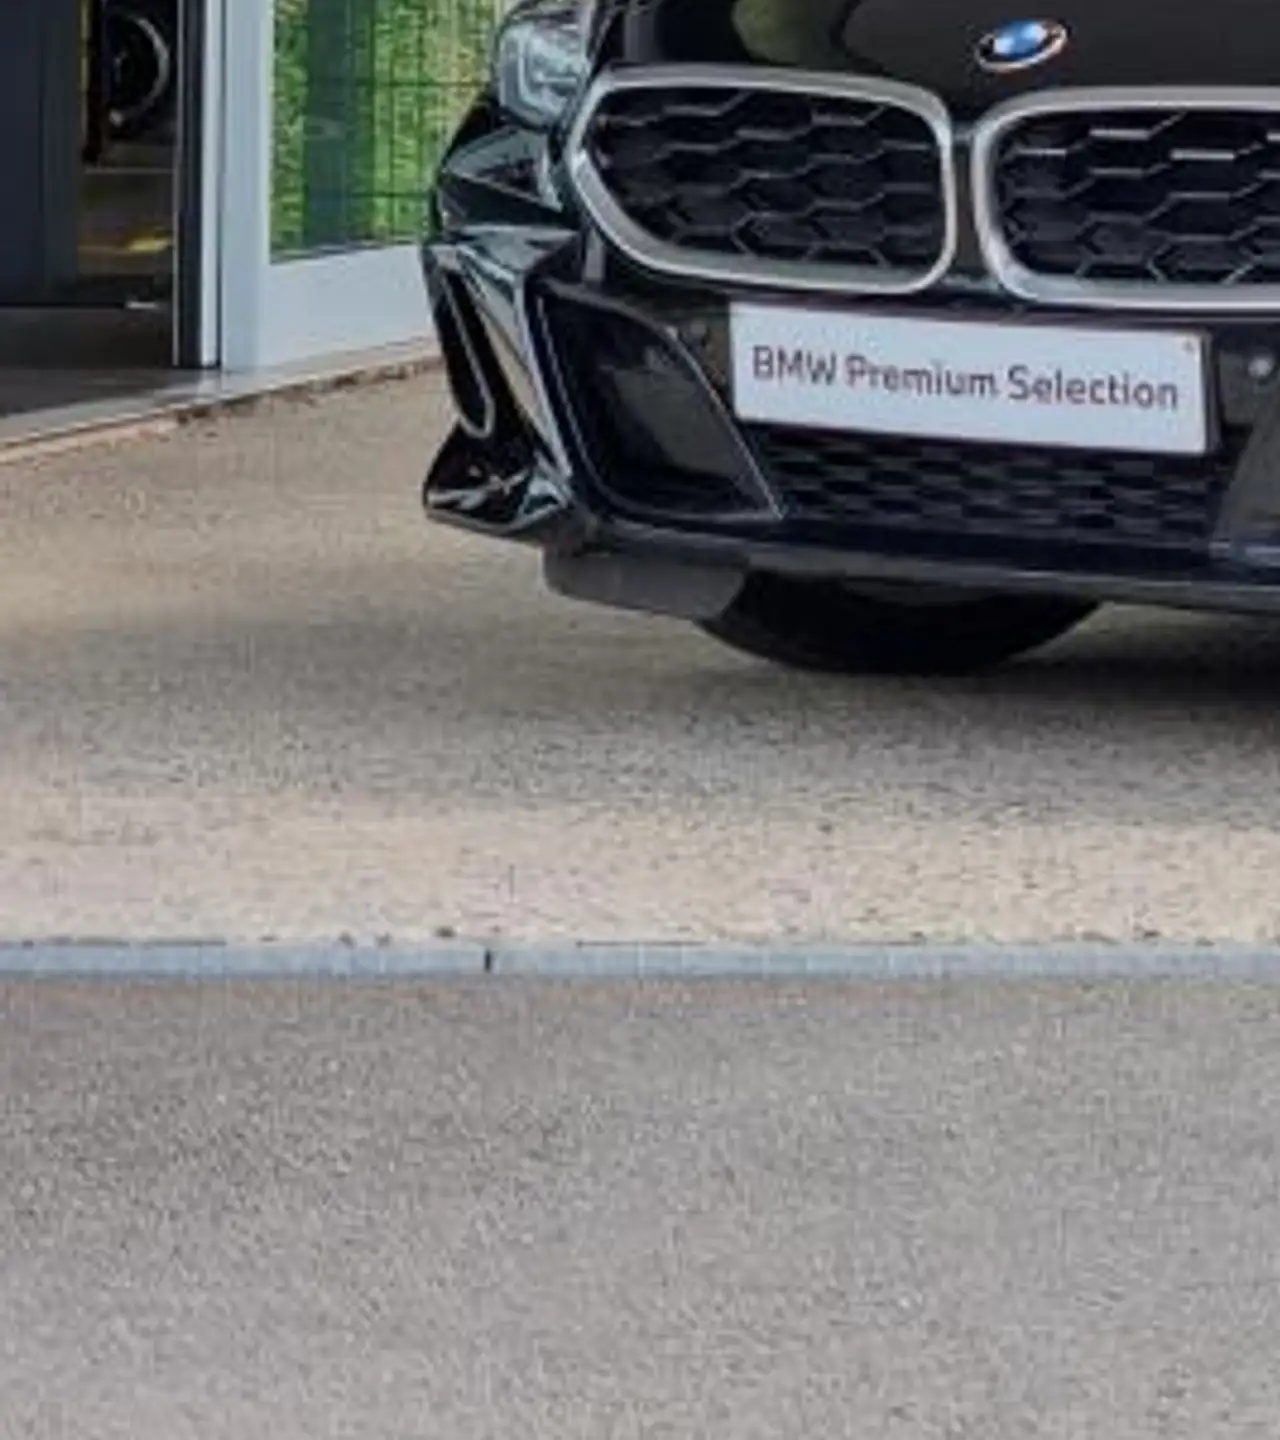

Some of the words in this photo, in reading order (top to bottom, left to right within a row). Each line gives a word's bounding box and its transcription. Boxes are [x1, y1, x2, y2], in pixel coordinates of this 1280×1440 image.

[752, 345, 838, 386] BMW
[845, 354, 999, 397] Premium
[1006, 363, 1179, 411] Selection
